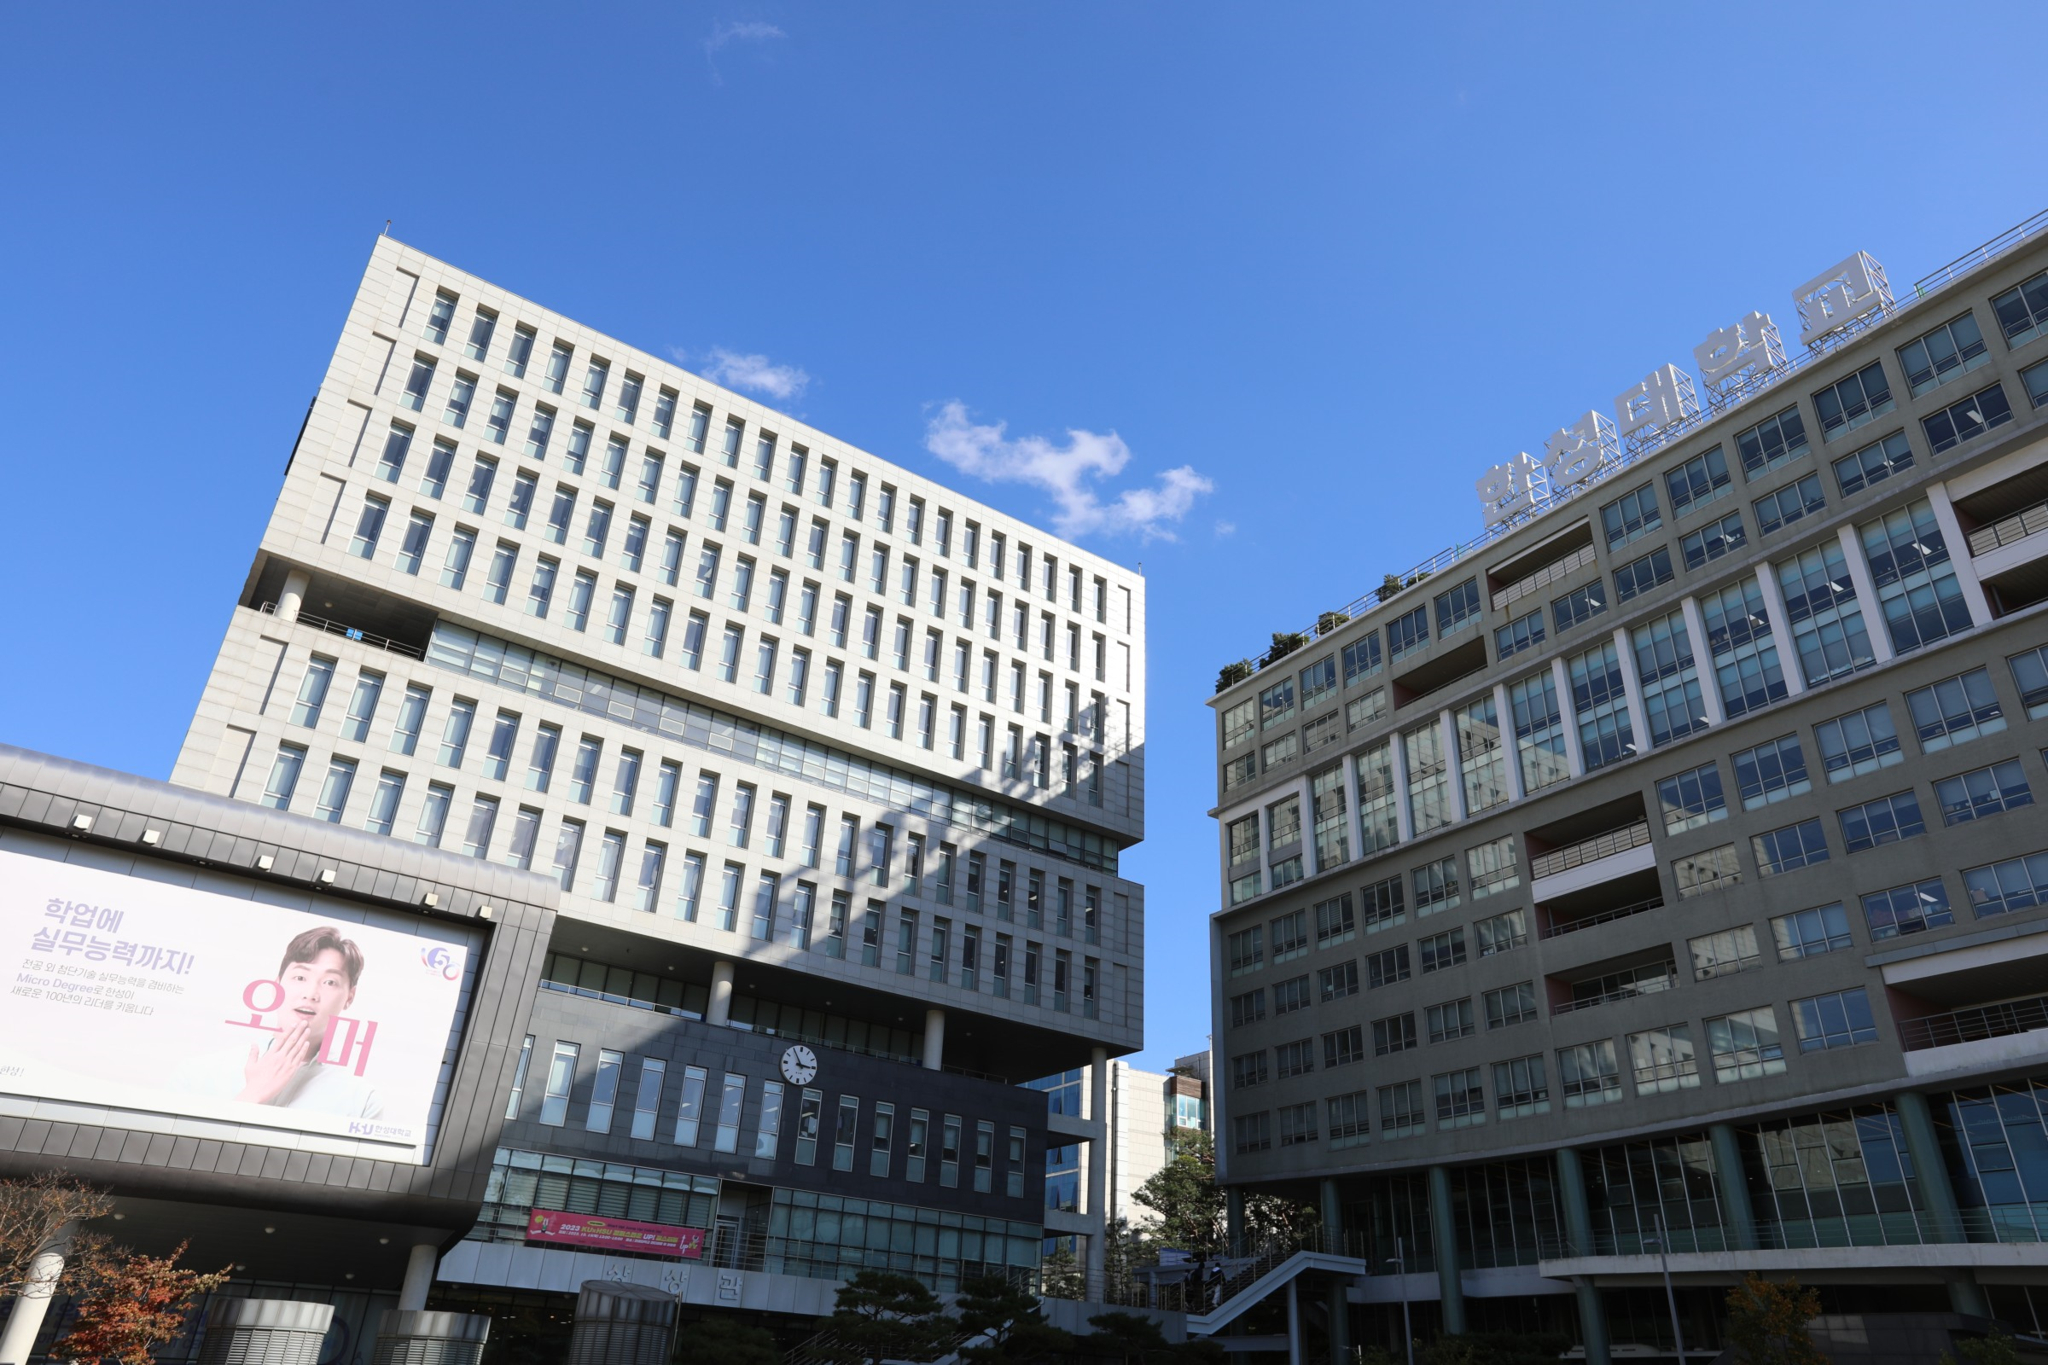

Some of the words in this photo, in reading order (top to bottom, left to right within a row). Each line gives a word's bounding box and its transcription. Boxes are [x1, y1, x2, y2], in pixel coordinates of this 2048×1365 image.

[1476, 250, 1884, 527] 한성대학교
[44, 897, 124, 934] 학업에
[31, 926, 195, 975] 실무능력까지!
[16, 972, 50, 988] Micro
[52, 977, 105, 996] Degree로
[105, 985, 135, 1001] 한성이
[22, 958, 43, 971] 전공
[45, 963, 56, 973] 외
[57, 964, 97, 981] 첨단기술
[98, 971, 146, 988] 실무능력을
[148, 979, 185, 995] 겸비하는
[10, 985, 42, 999] 새로운
[45, 989, 82, 1005] 100년의
[83, 996, 114, 1011] 리더를
[115, 1002, 154, 1017] 키웁니다
[375, 1125, 412, 1137] 한성대학교
[560, 1223, 581, 1232] 2023
[643, 1233, 656, 1241] UP!
